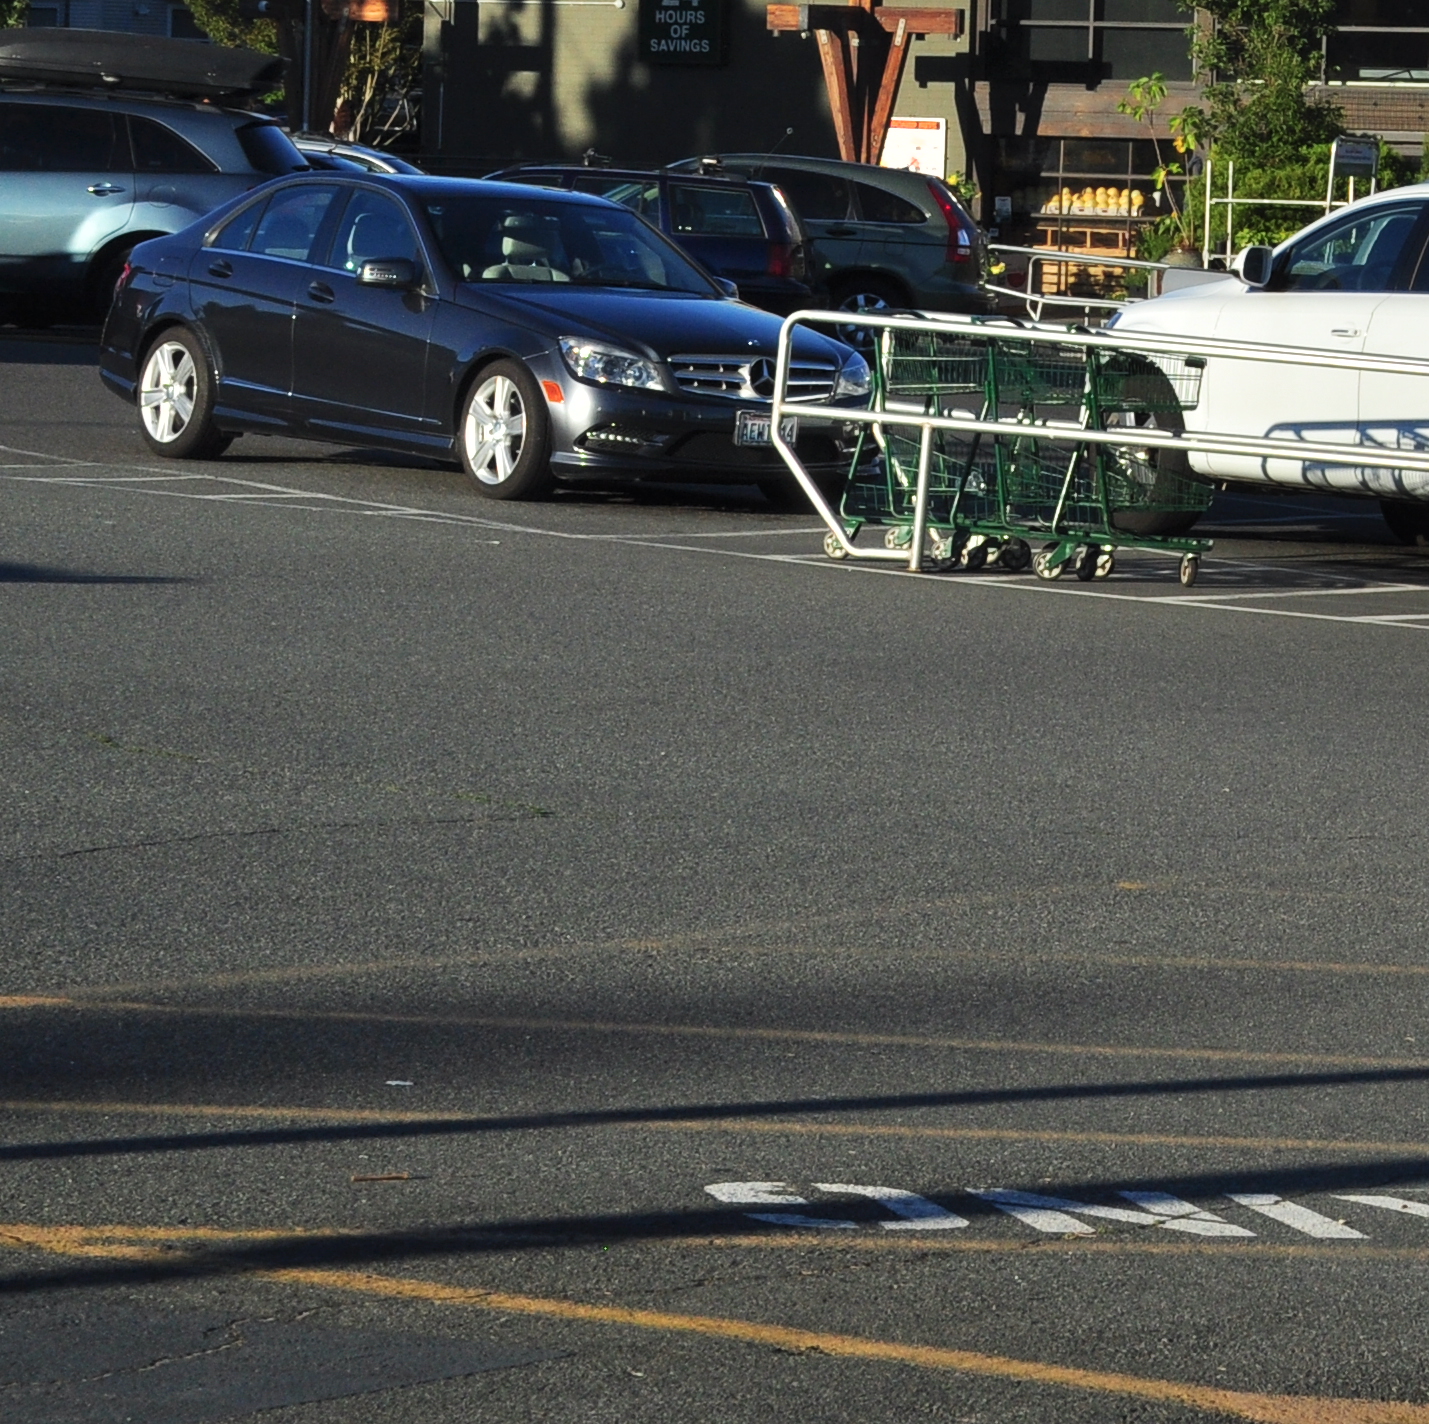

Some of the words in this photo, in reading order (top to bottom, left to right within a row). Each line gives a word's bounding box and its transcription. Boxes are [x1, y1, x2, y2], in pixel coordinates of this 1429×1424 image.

[656, 10, 705, 23] HOURS
[670, 25, 690, 38] OF
[650, 39, 710, 52] SAVINGS
